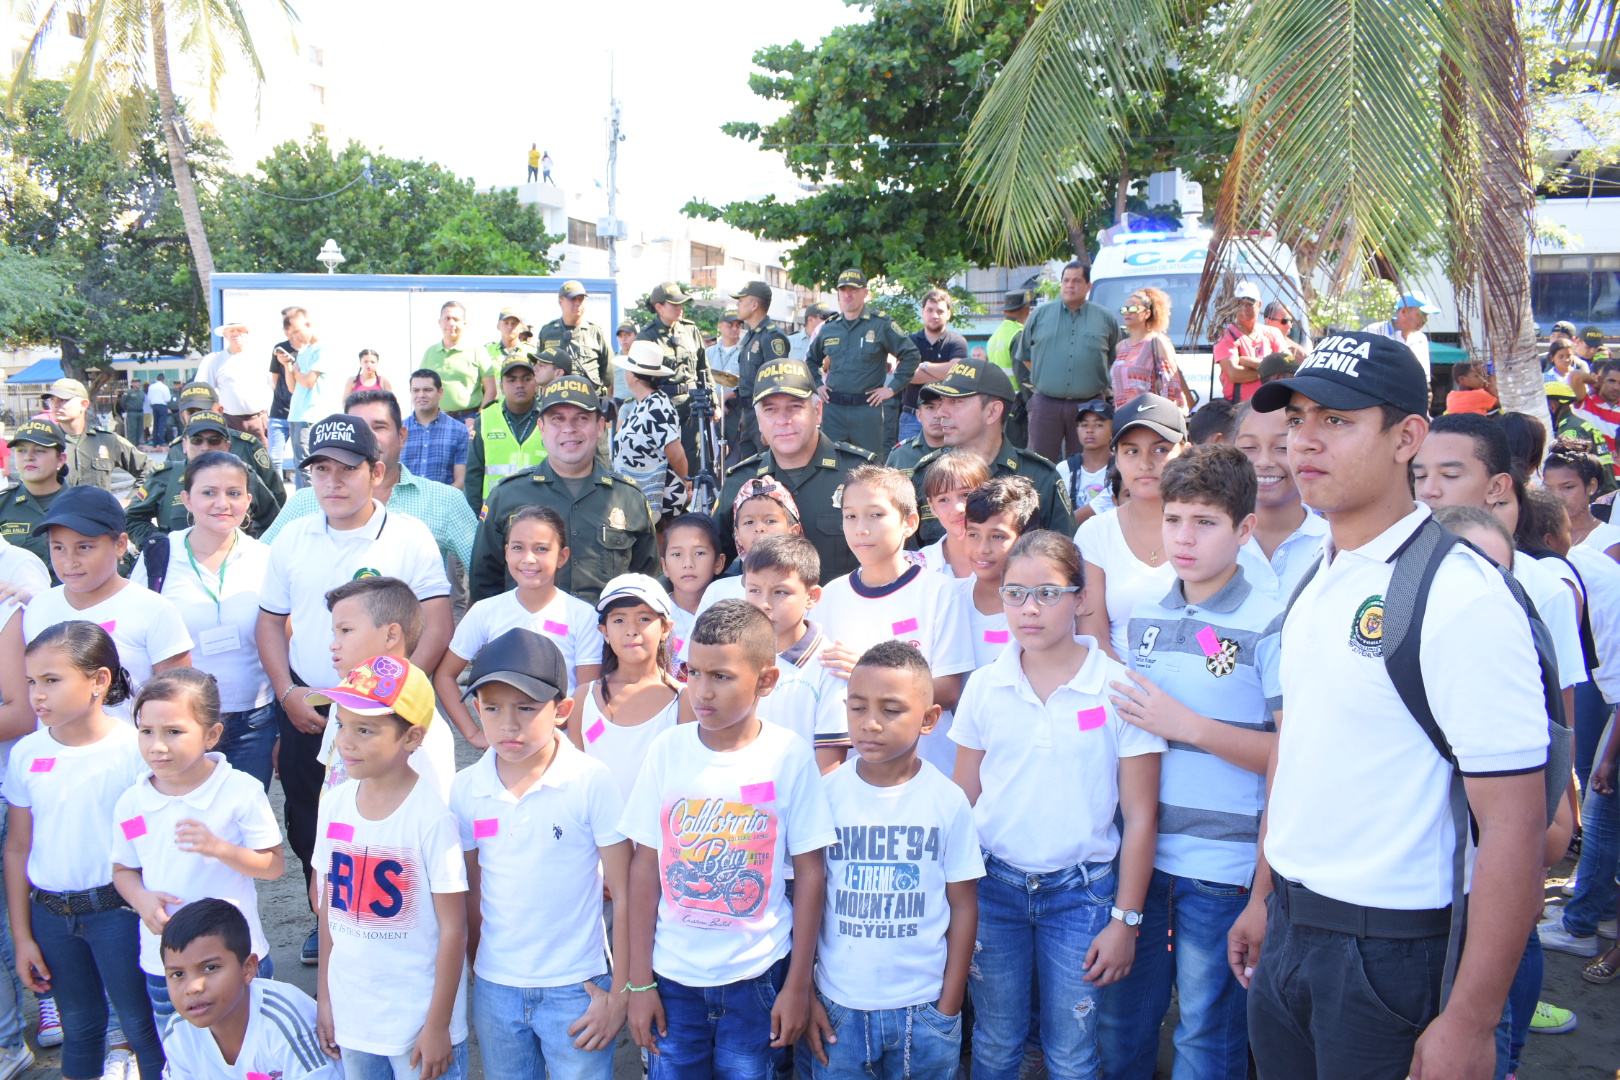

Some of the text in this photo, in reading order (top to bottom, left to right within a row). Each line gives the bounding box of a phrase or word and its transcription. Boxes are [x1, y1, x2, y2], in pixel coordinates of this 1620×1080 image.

[758, 363, 807, 382] POLICIA
[181, 387, 210, 398] POLICIA
[545, 380, 590, 397] POLICIA
[190, 412, 224, 425] POLICIA
[315, 421, 356, 435] CIVICA
[313, 431, 355, 446] JUVENIL
[1139, 625, 1161, 657] 9
[669, 798, 769, 849] California
[848, 864, 896, 891] X-TREME
[835, 889, 925, 920] MOUNTAIN
[362, 931, 409, 940] MOMENT
[839, 920, 918, 939] BICYCLES
